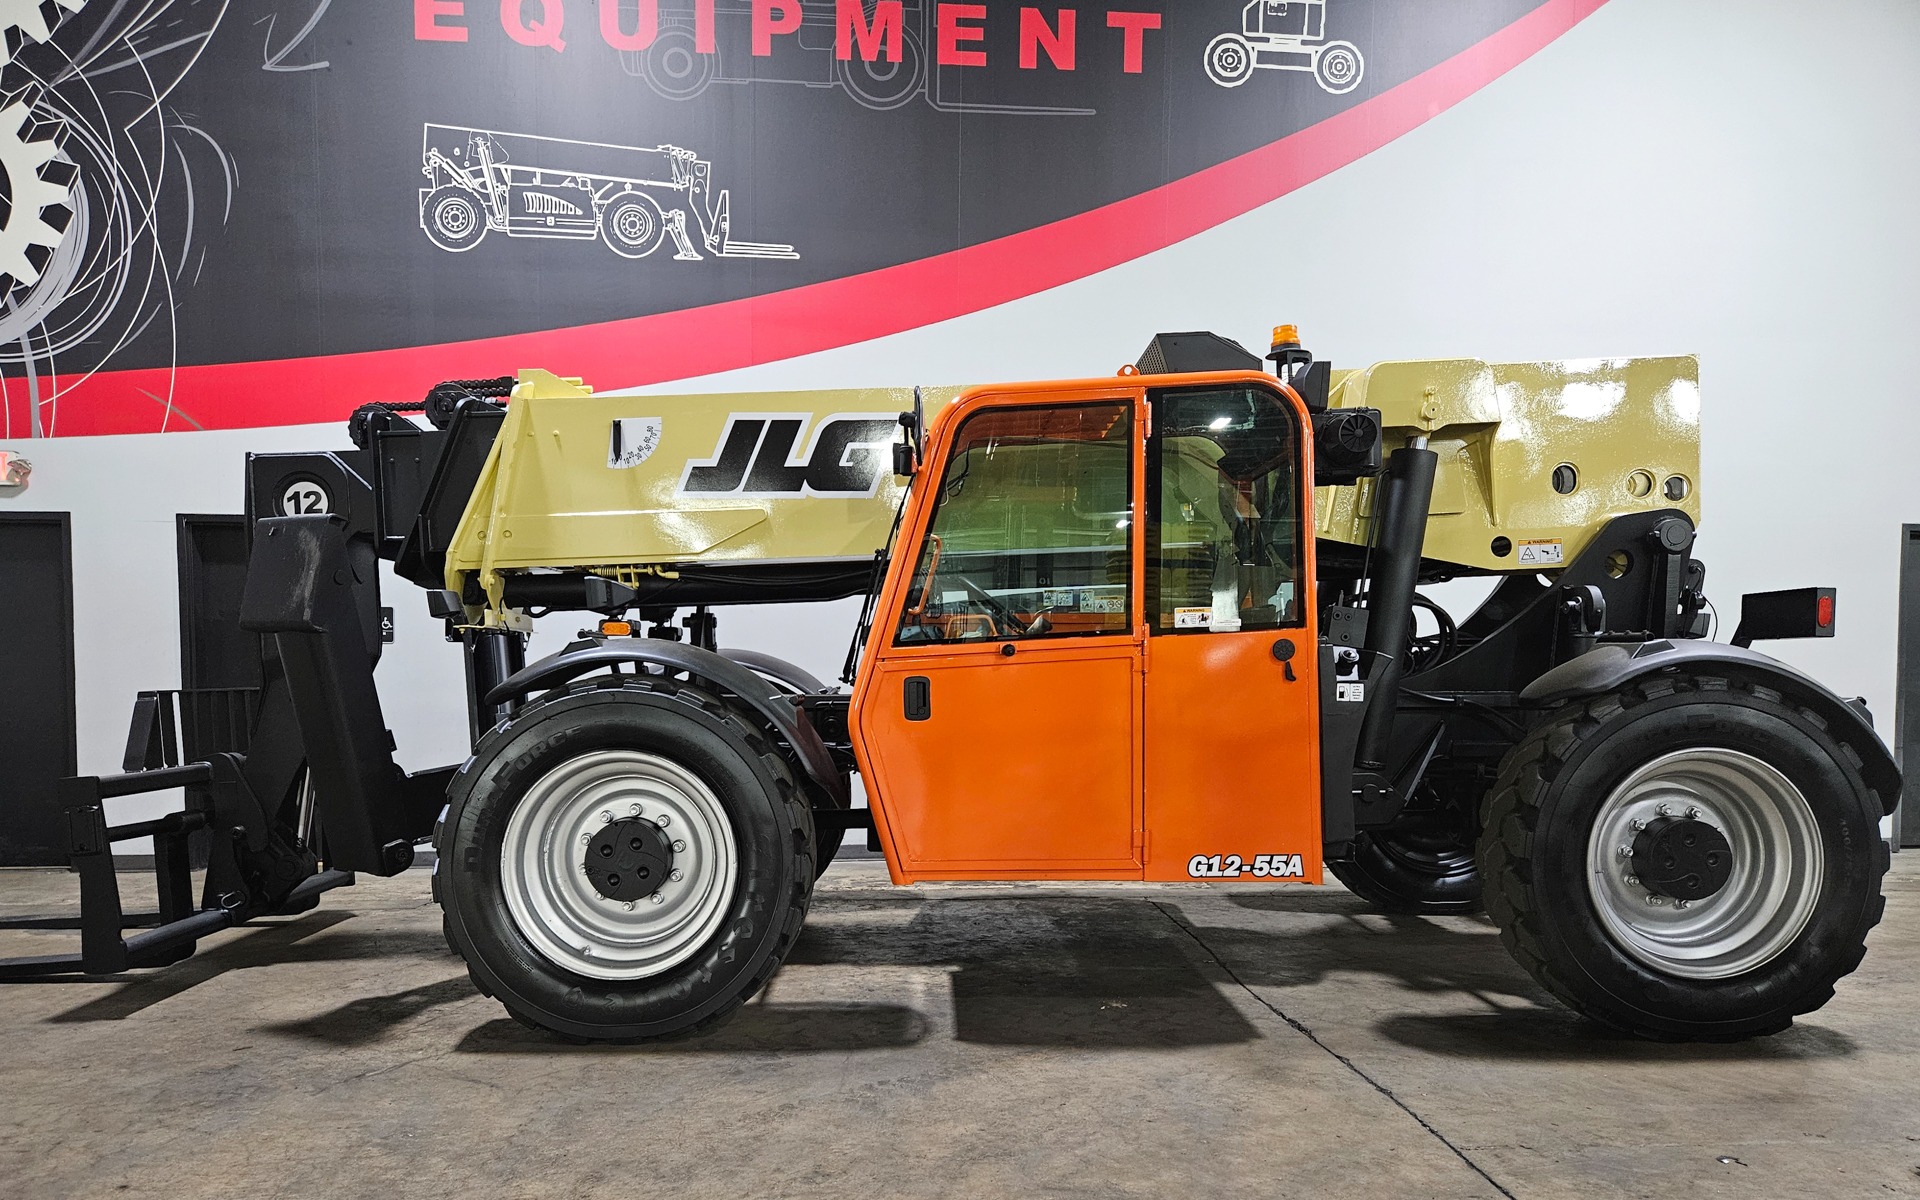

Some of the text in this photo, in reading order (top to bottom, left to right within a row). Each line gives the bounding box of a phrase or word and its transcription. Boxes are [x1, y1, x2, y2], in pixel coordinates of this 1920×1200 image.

[414, 0, 1162, 73] EQUIPMENT
[681, 418, 900, 493] JLG
[286, 490, 324, 514] 12
[1187, 854, 1304, 878] G12-55A
